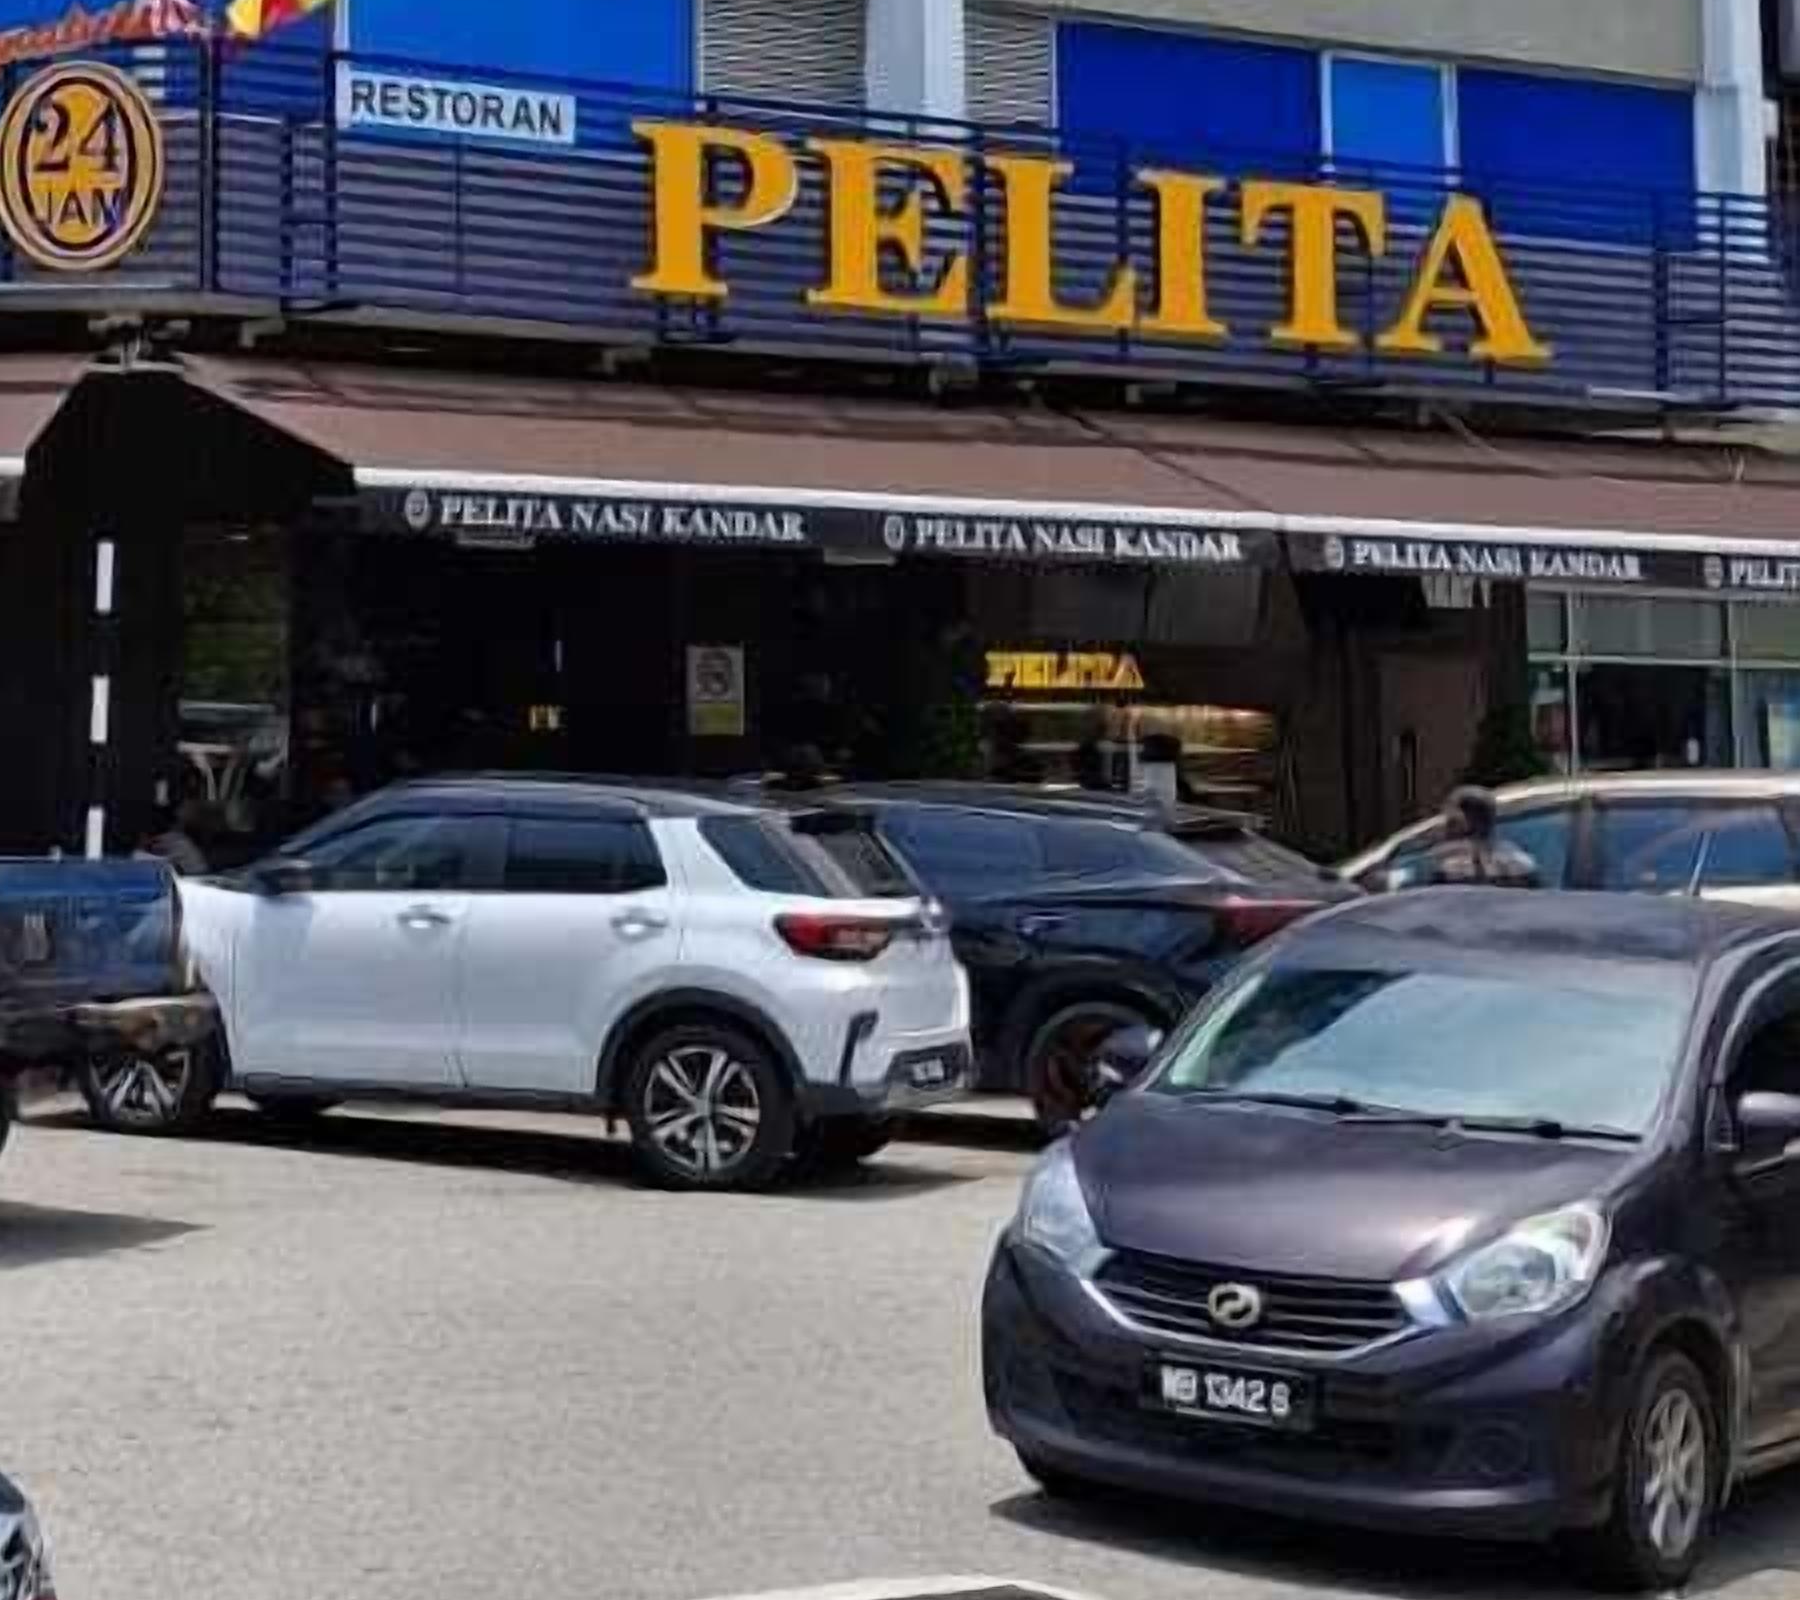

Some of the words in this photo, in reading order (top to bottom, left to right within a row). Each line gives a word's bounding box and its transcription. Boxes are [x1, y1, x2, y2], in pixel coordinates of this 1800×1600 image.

[350, 78, 563, 137] RESTORAN
[31, 101, 119, 172] 24
[631, 120, 1553, 367] PELITA
[440, 496, 562, 530] PELITA
[571, 502, 652, 534] NASI
[660, 507, 806, 541] KANDAR
[916, 519, 1026, 551] PELITA
[1033, 524, 1104, 554] NASI
[985, 652, 1144, 689] PELITA
